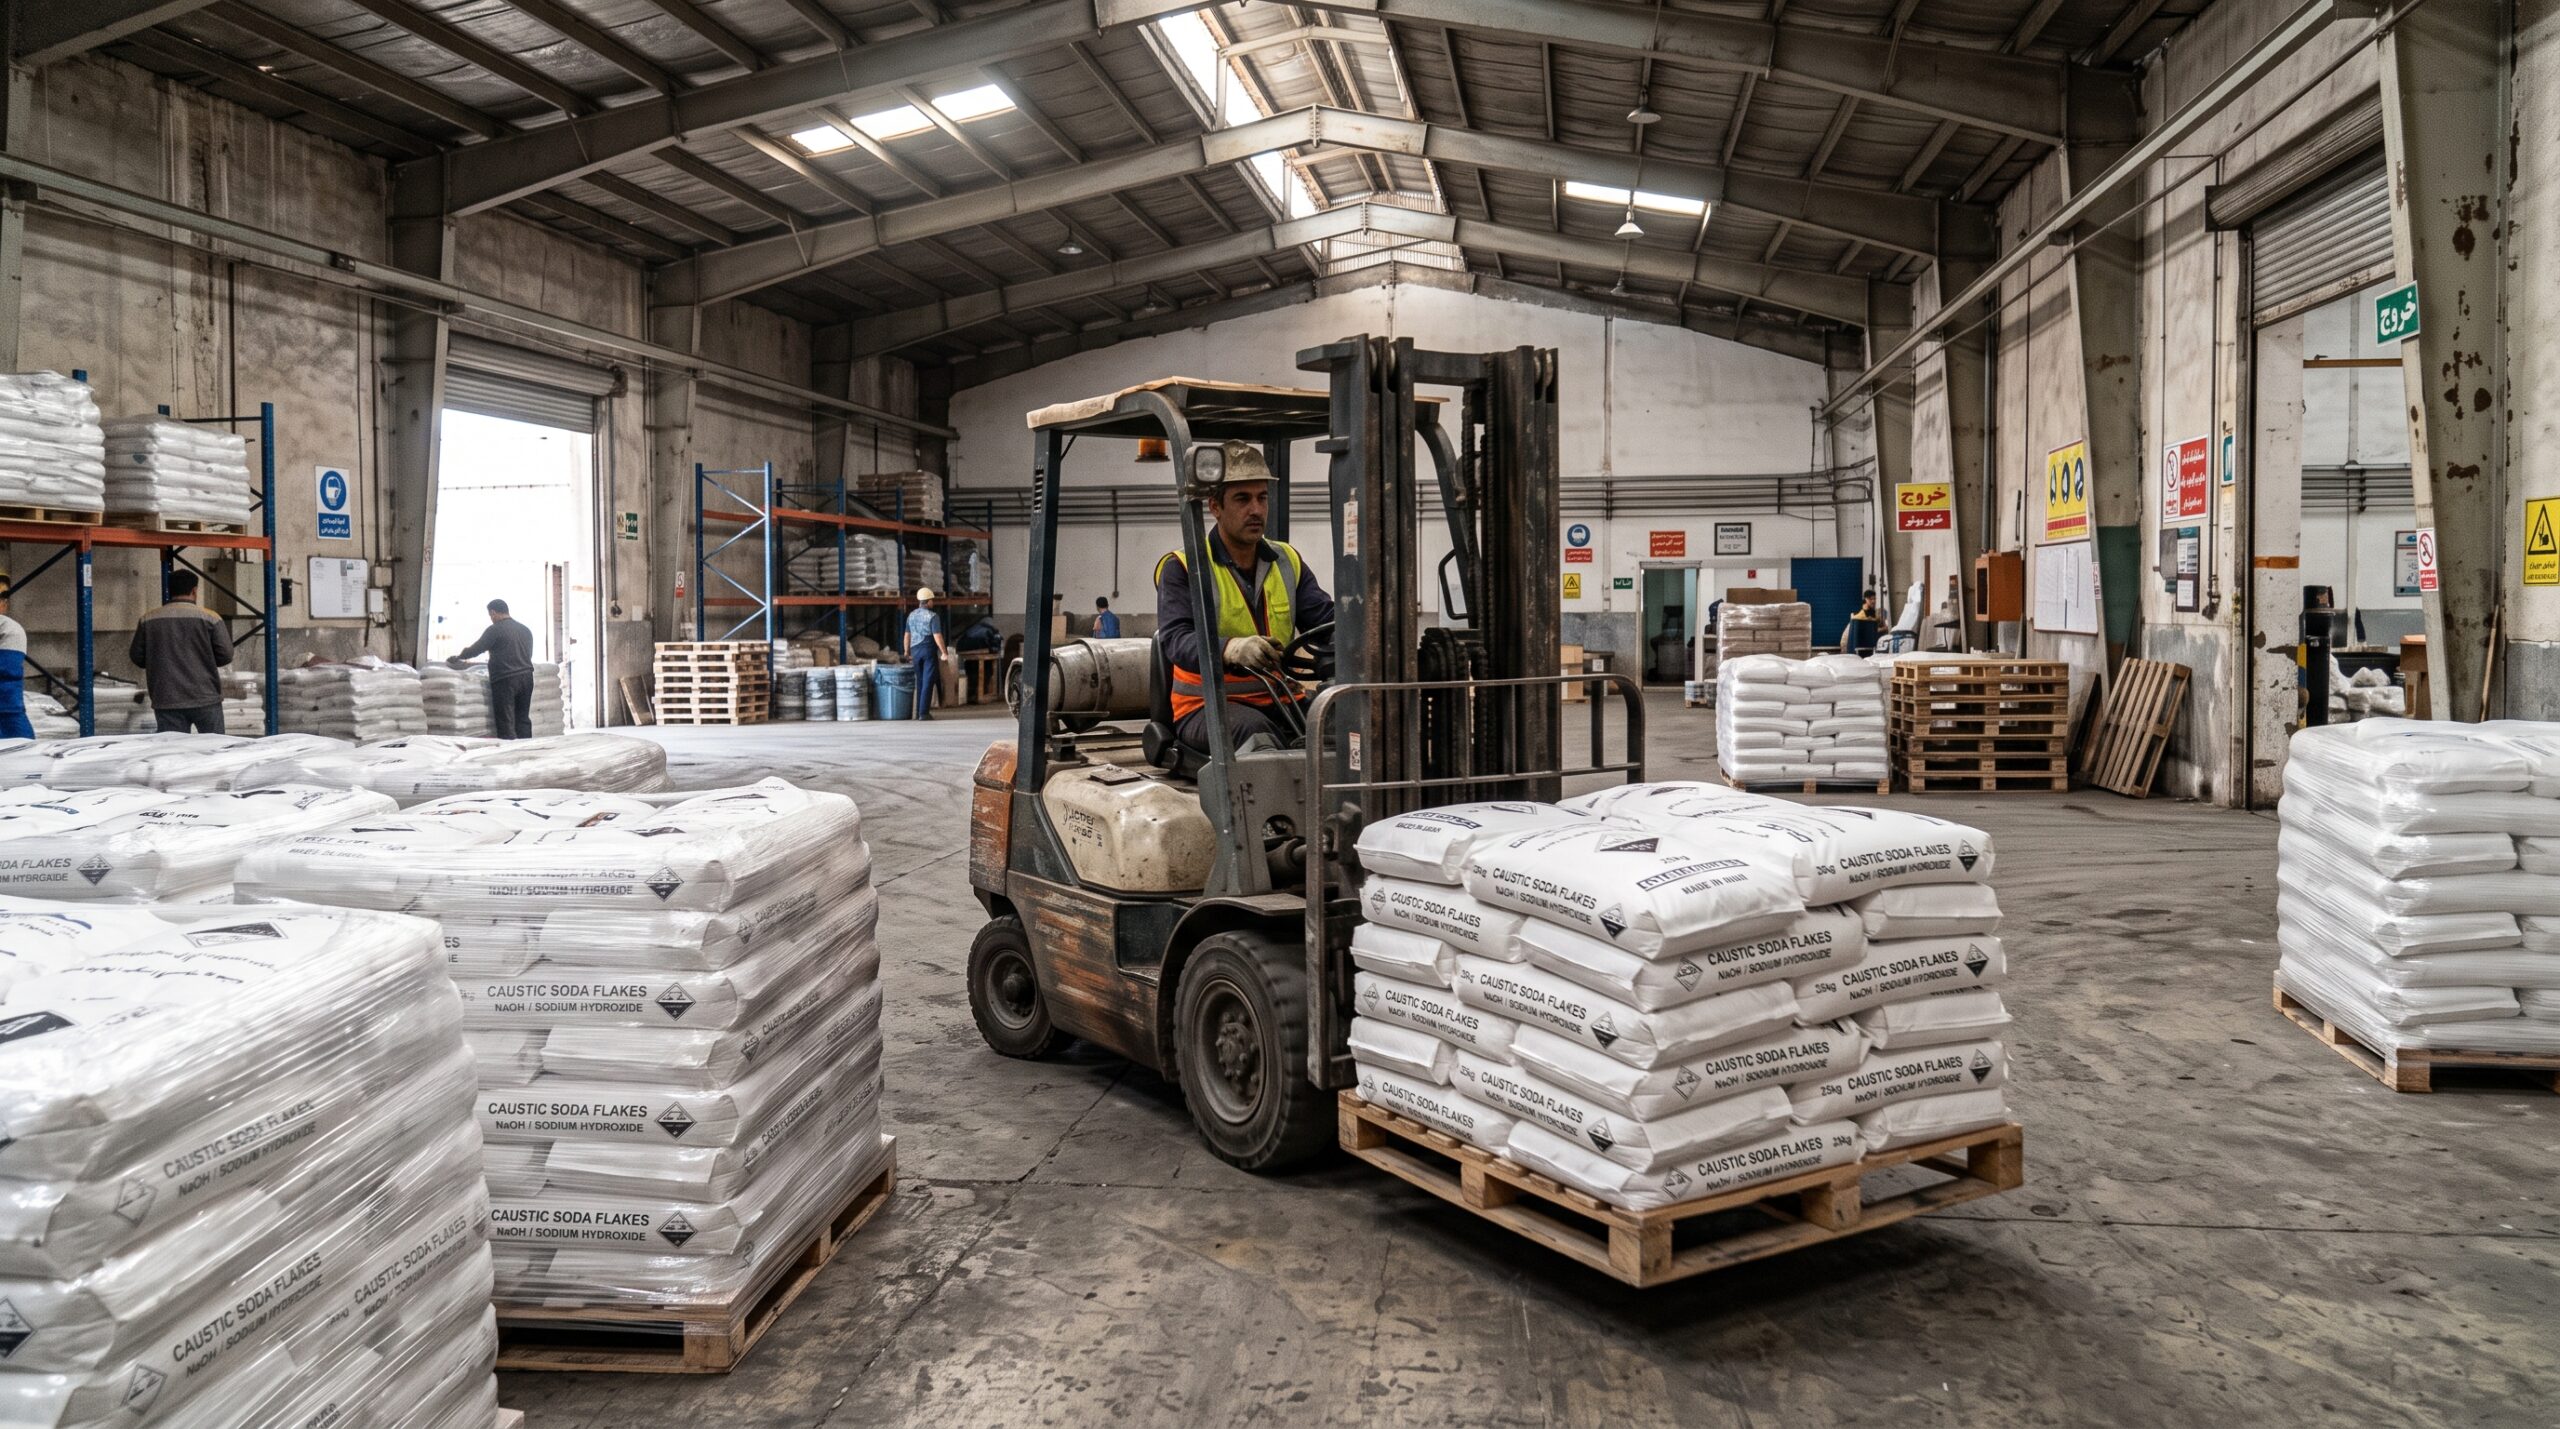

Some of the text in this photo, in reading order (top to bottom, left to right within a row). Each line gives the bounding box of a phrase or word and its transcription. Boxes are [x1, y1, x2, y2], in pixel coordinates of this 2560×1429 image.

[2380, 291, 2416, 336] خروج
[1900, 486, 1946, 506] خروج
[21, 858, 72, 868] FLAKES
[1840, 852, 1884, 869] CAUSTIC
[1493, 867, 1531, 888] CAUSTIC
[1559, 887, 1598, 910] FLAKES
[1448, 908, 1480, 928] FLAKES
[1708, 930, 1832, 966] CAUSTIC SODA FLAKES
[1842, 966, 1887, 986] CAUSTIC
[1890, 960, 1919, 974] SODA
[488, 985, 546, 998] CAUSTIC
[550, 985, 590, 997] SODA
[593, 985, 647, 998] FLAKES
[1480, 974, 1518, 994] CAUSTIC
[1519, 986, 1546, 1002] SODA
[528, 1003, 532, 1012] /
[535, 1003, 578, 1012] SODIUM
[1385, 990, 1479, 1030] CAUSTIC SODA FLAKES
[1706, 1054, 1754, 1076] CAUSTIC
[1756, 1049, 1788, 1064] SODA
[1481, 1072, 1518, 1094] CAUSTIC
[1520, 1087, 1544, 1106] SODA
[1848, 1070, 1892, 1090] CAUSTIC
[1894, 1064, 1925, 1078] SODA
[488, 1102, 648, 1118] CAUSTIC SODA FLAKES
[1382, 1082, 1416, 1104] CAUSTIC
[1416, 1096, 1440, 1114] SODA
[1441, 1106, 1474, 1128] FLAKES
[496, 1120, 644, 1132] NaOH / SODIUM HYDROXIDE
[163, 1140, 227, 1179] CAUSTIC
[1698, 1154, 1746, 1176] CAUSTIC
[1748, 1147, 1782, 1164] SODA
[1781, 1136, 1823, 1157] FLAKES
[491, 1210, 650, 1226] CAUSTIC SODA FLAKES
[496, 1227, 646, 1241] NaOH / SODIUM HYDROXIDE
[354, 1262, 402, 1305] CAUSTIC
[403, 1241, 432, 1270] SODA
[172, 1311, 234, 1362] CAUSTIC
[236, 1287, 274, 1320] SODA
[274, 1252, 322, 1296] FLAKES
